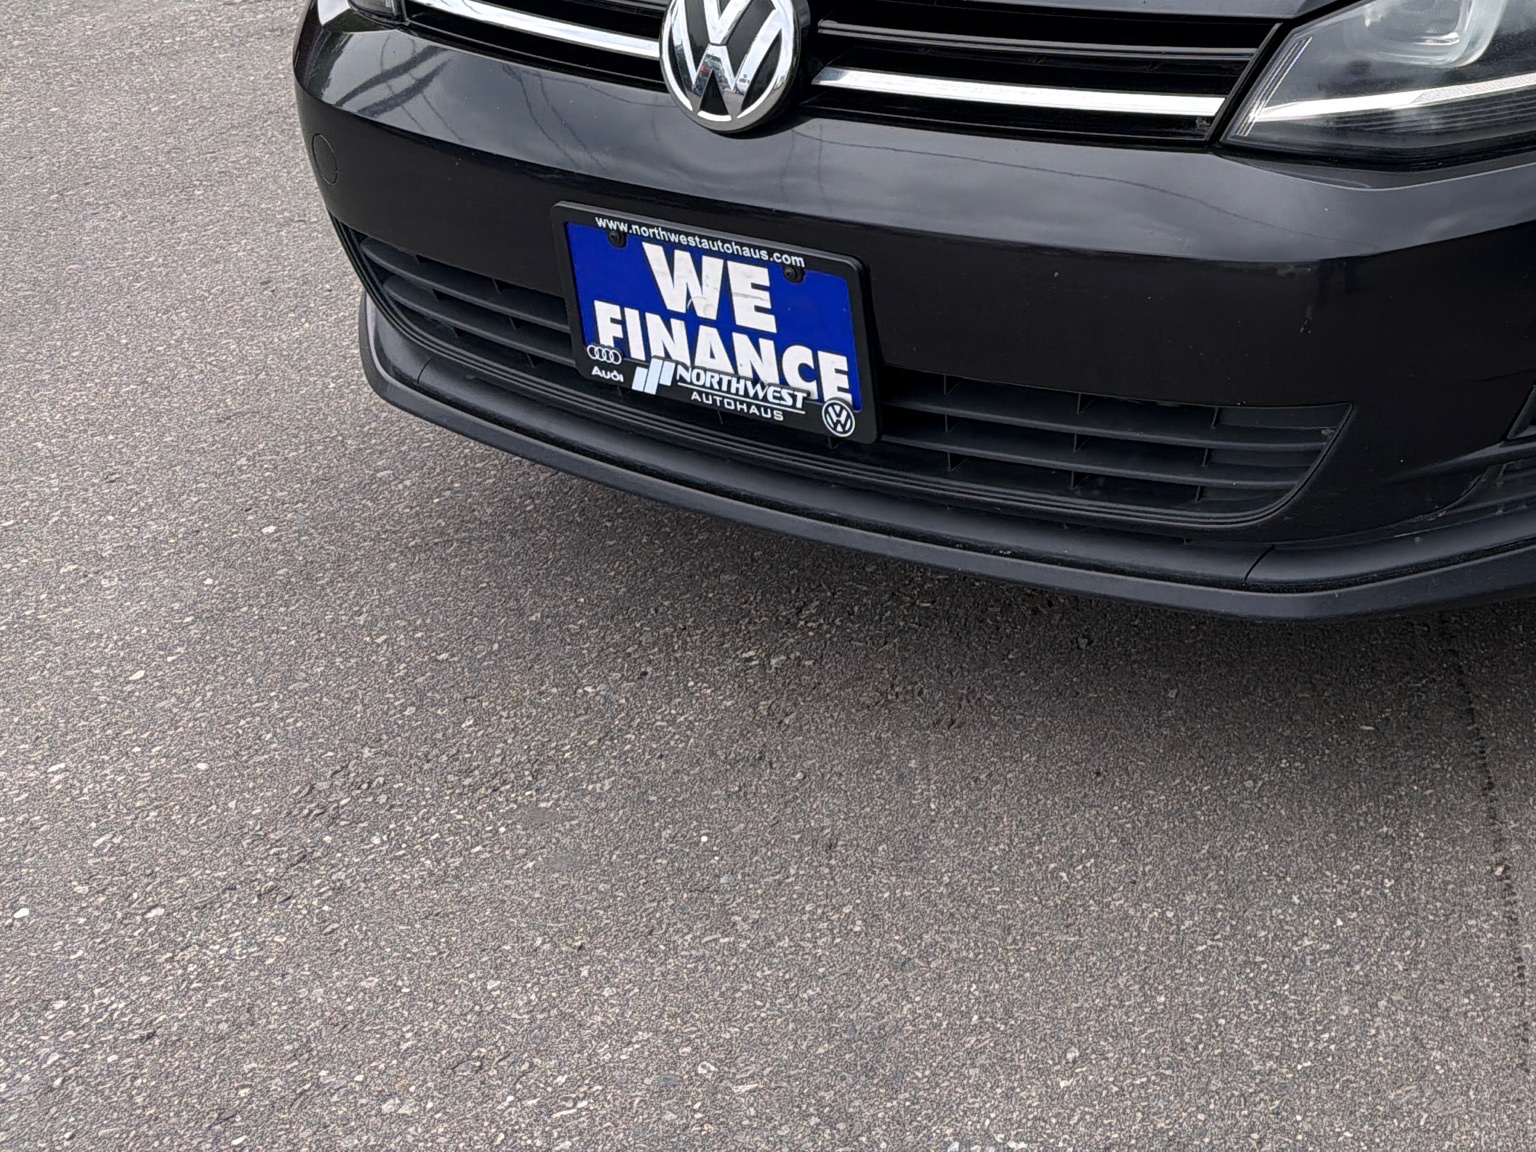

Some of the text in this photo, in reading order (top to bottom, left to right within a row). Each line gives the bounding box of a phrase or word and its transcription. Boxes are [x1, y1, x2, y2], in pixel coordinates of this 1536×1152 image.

[595, 216, 806, 268] www.northwestautohaus.com
[641, 241, 778, 334] WE
[593, 299, 854, 407] FINANCE
[676, 364, 808, 409] NORTHWEST
[690, 391, 785, 422] AUTOHAUS
